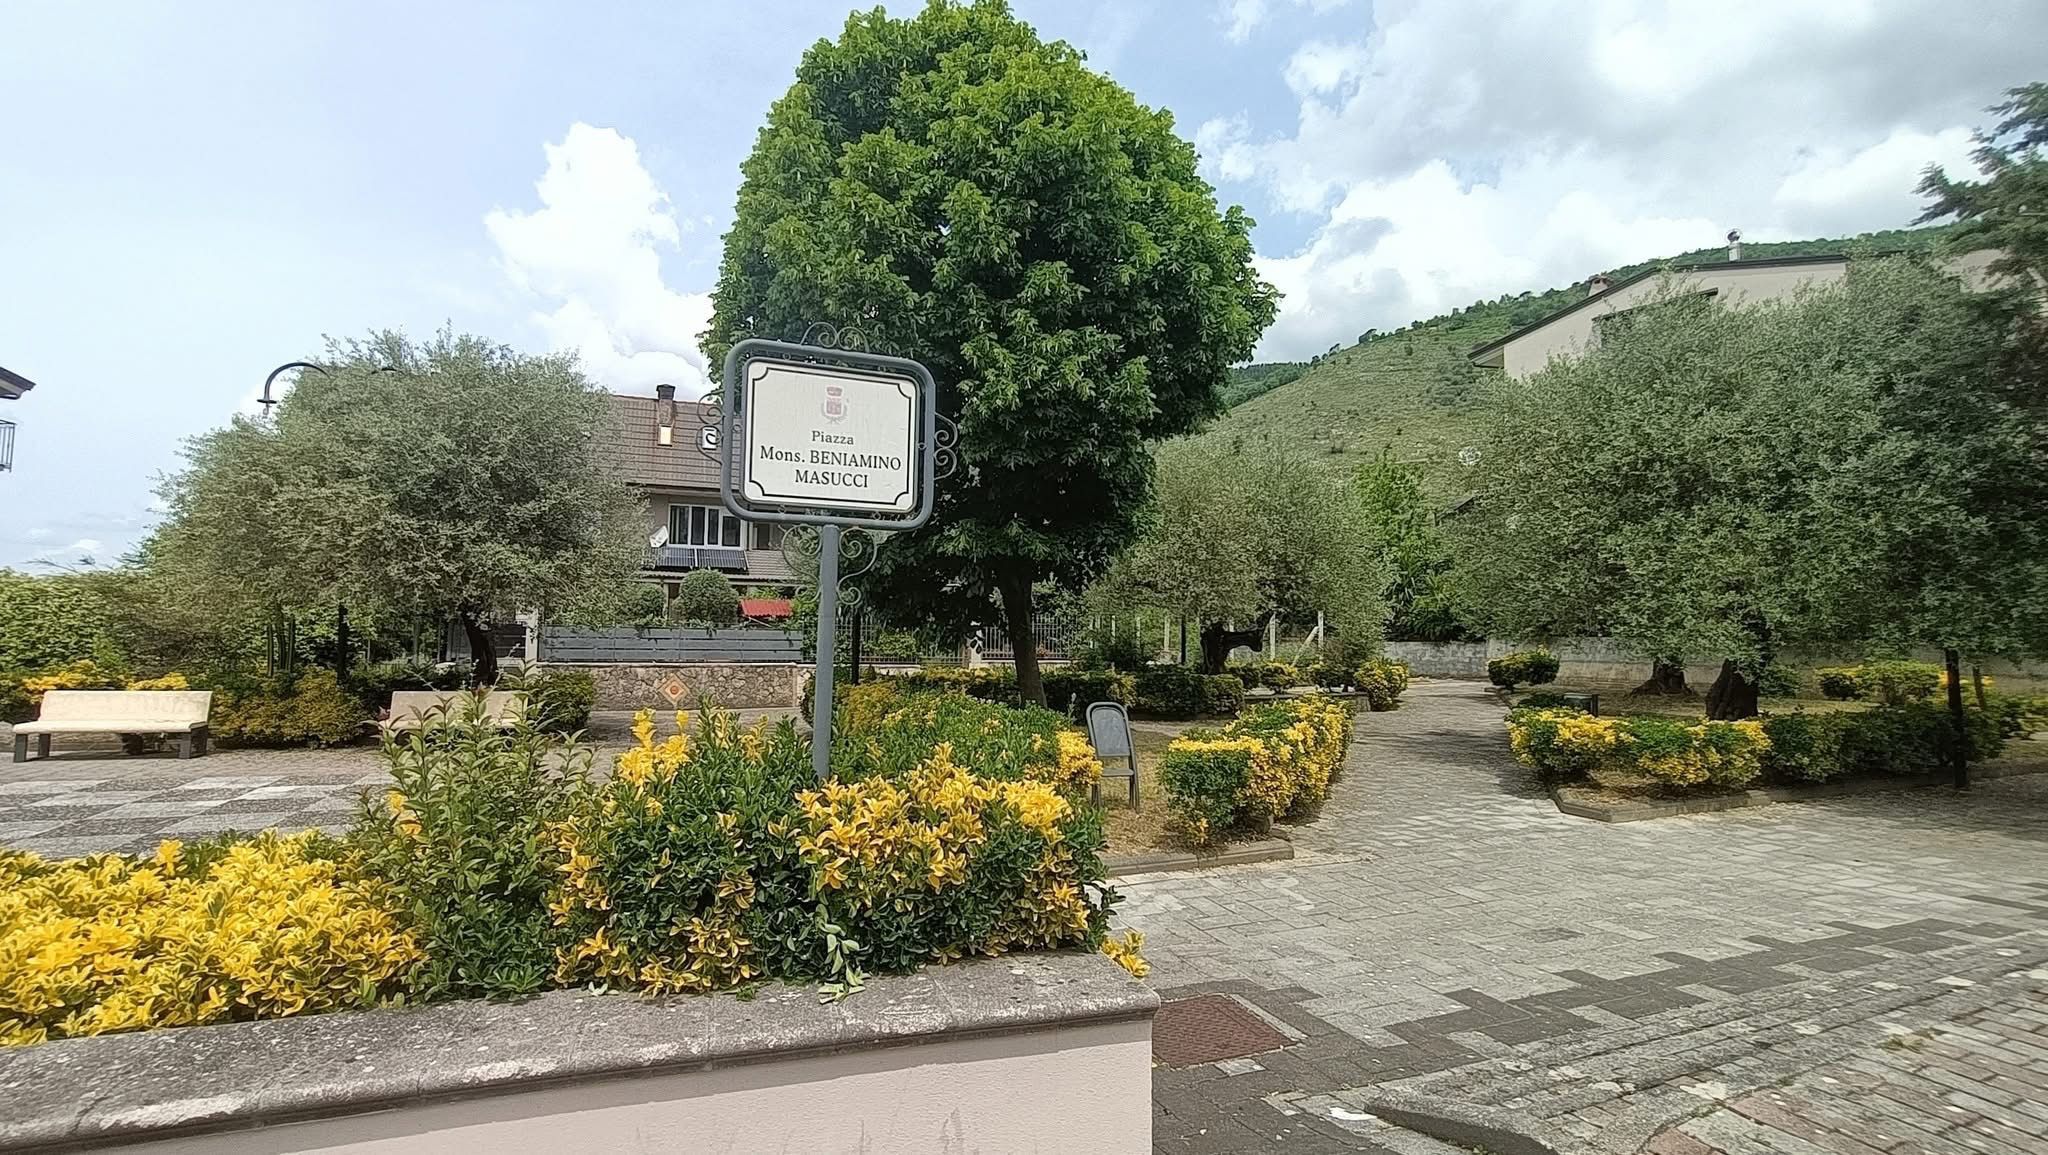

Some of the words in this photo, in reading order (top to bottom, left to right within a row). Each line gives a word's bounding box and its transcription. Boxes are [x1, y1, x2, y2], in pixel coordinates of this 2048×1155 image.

[811, 430, 854, 445] Piazza
[760, 445, 806, 463] Mons.
[809, 450, 902, 471] BENIAMINO
[795, 469, 868, 488] MASUCCI
